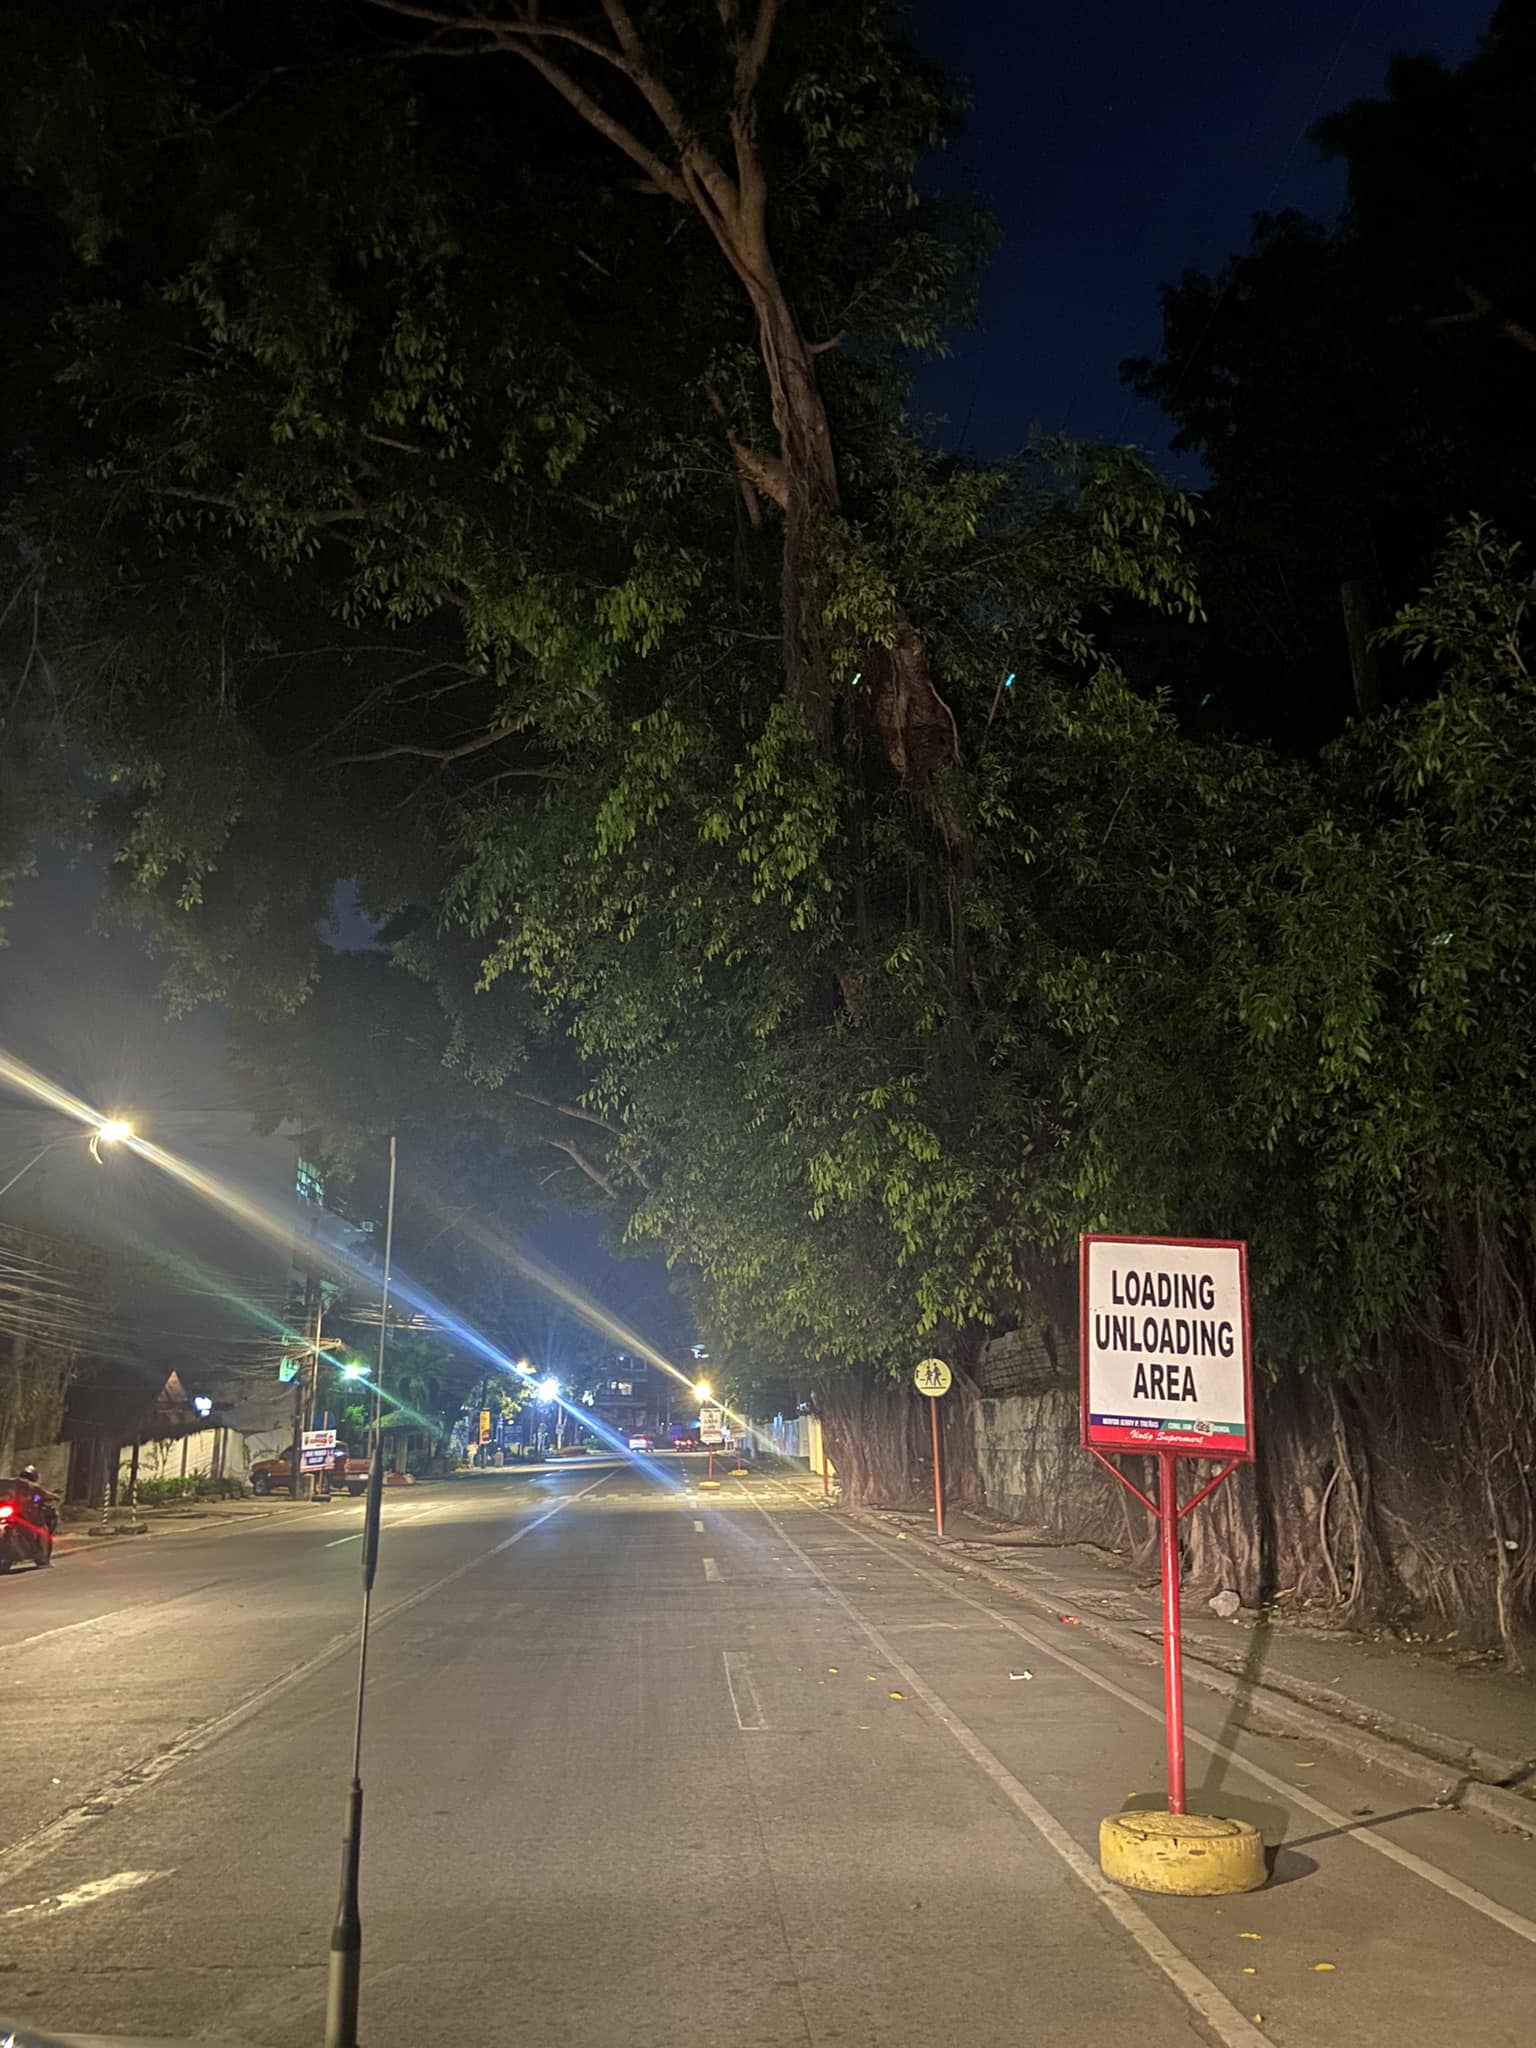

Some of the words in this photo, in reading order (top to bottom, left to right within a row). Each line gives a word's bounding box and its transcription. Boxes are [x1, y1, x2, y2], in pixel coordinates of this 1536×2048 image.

[1111, 1270, 1215, 1310] LOADING
[1095, 1314, 1234, 1358] UNLOADING
[1132, 1363, 1198, 1402] AREA
